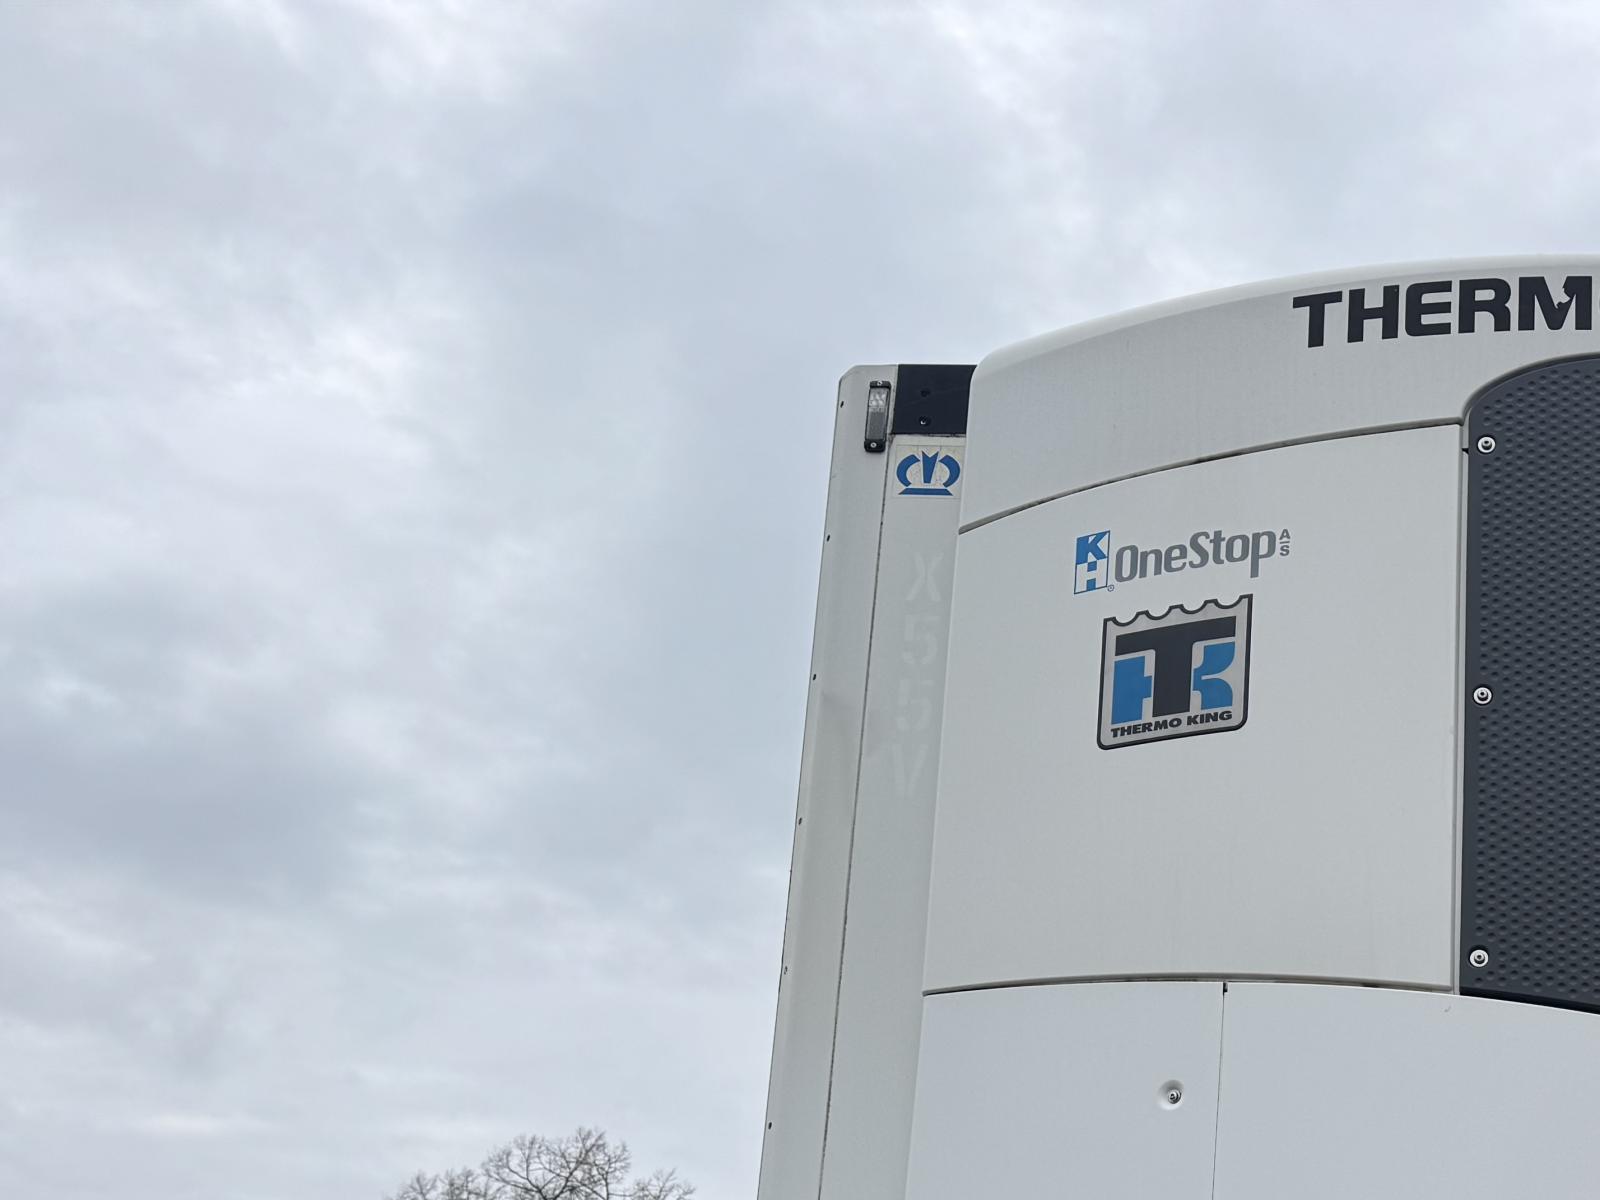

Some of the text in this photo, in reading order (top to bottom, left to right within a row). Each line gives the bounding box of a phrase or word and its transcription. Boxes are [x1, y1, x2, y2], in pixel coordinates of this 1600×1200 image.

[1114, 529, 1277, 583] OneStop
[1111, 709, 1233, 739] THERMO KING
